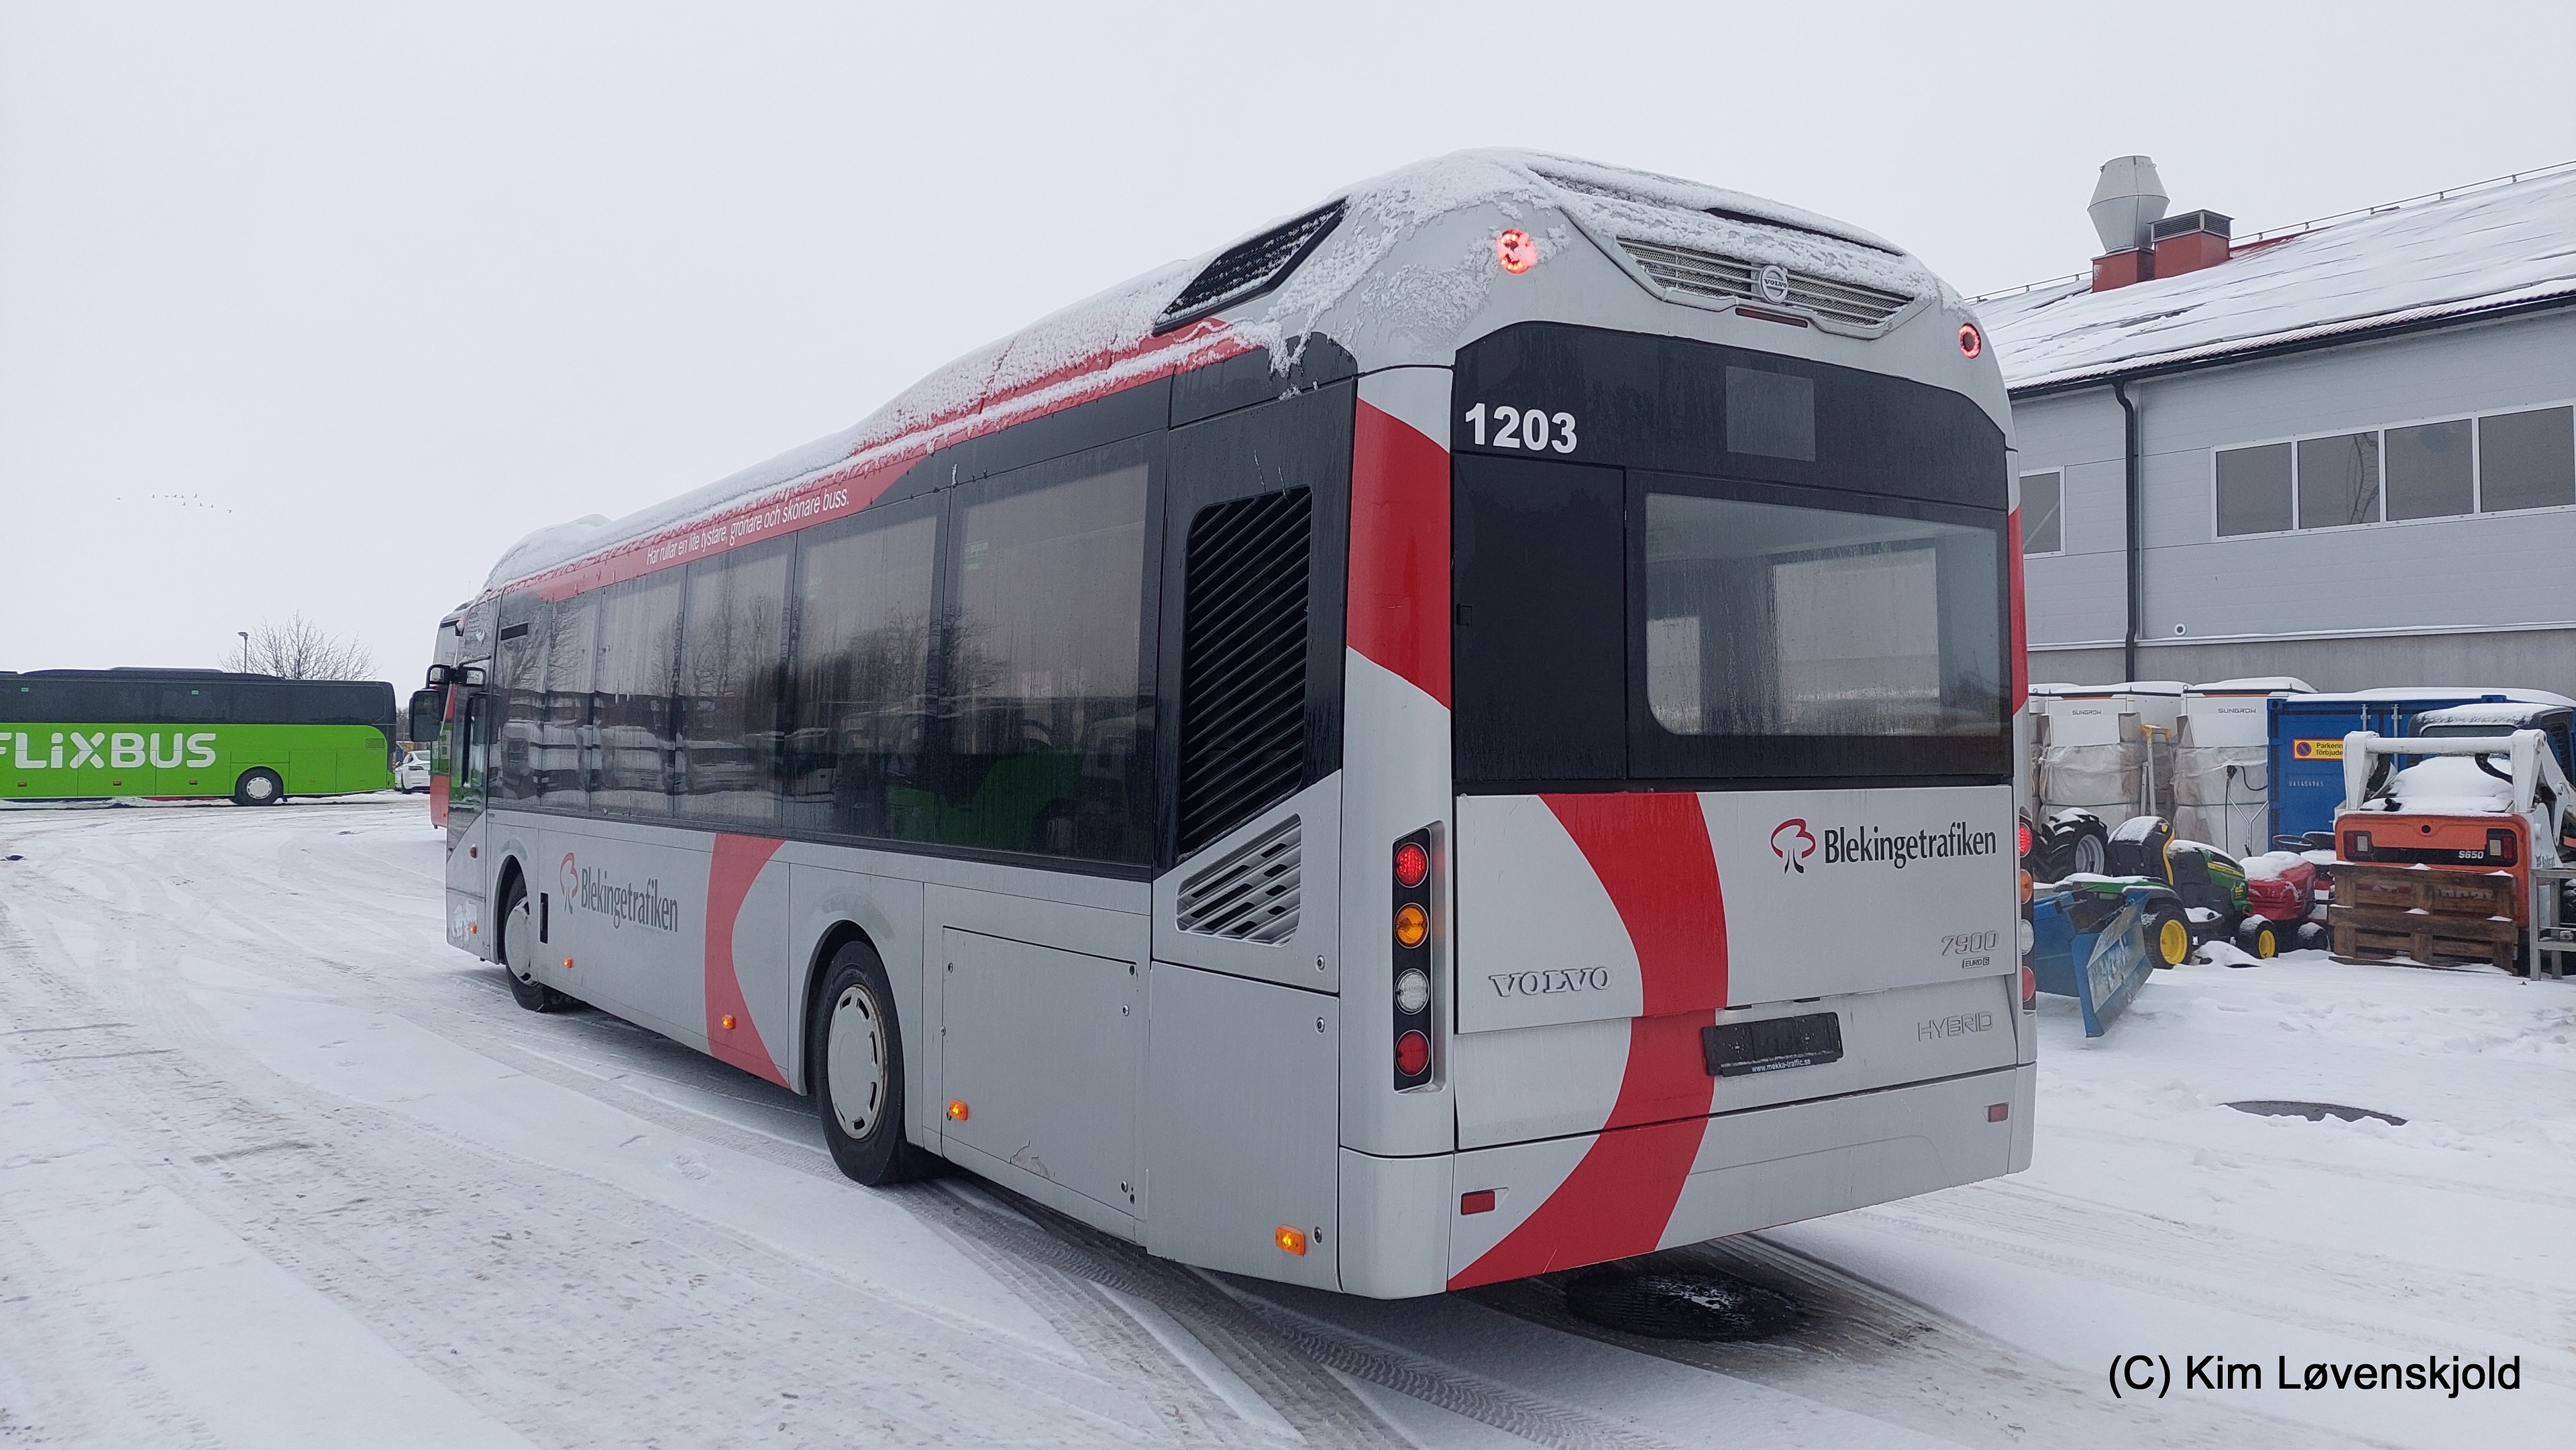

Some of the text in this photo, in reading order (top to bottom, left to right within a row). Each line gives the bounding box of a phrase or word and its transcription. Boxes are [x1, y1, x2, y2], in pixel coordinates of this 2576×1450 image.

[1764, 278, 1787, 288] VOLVO
[1465, 402, 1577, 453] 1203
[660, 540, 678, 562] rullar
[678, 539, 688, 555] en
[688, 532, 700, 552] lite
[700, 526, 728, 553] tystare,
[729, 514, 762, 547] grönare
[763, 503, 780, 528] och
[782, 496, 820, 523] skönare
[822, 488, 849, 512] buss.
[1824, 822, 1997, 870] Blekingetrafiken
[2459, 850, 2484, 860] S650
[581, 866, 678, 933] Blekingetrafiken
[1941, 930, 1998, 956] 7900
[1488, 966, 1611, 997] VOLVO
[1917, 1011, 1993, 1042] HYBRID
[1751, 1058, 1811, 1073] www.mekka-traffic.se
